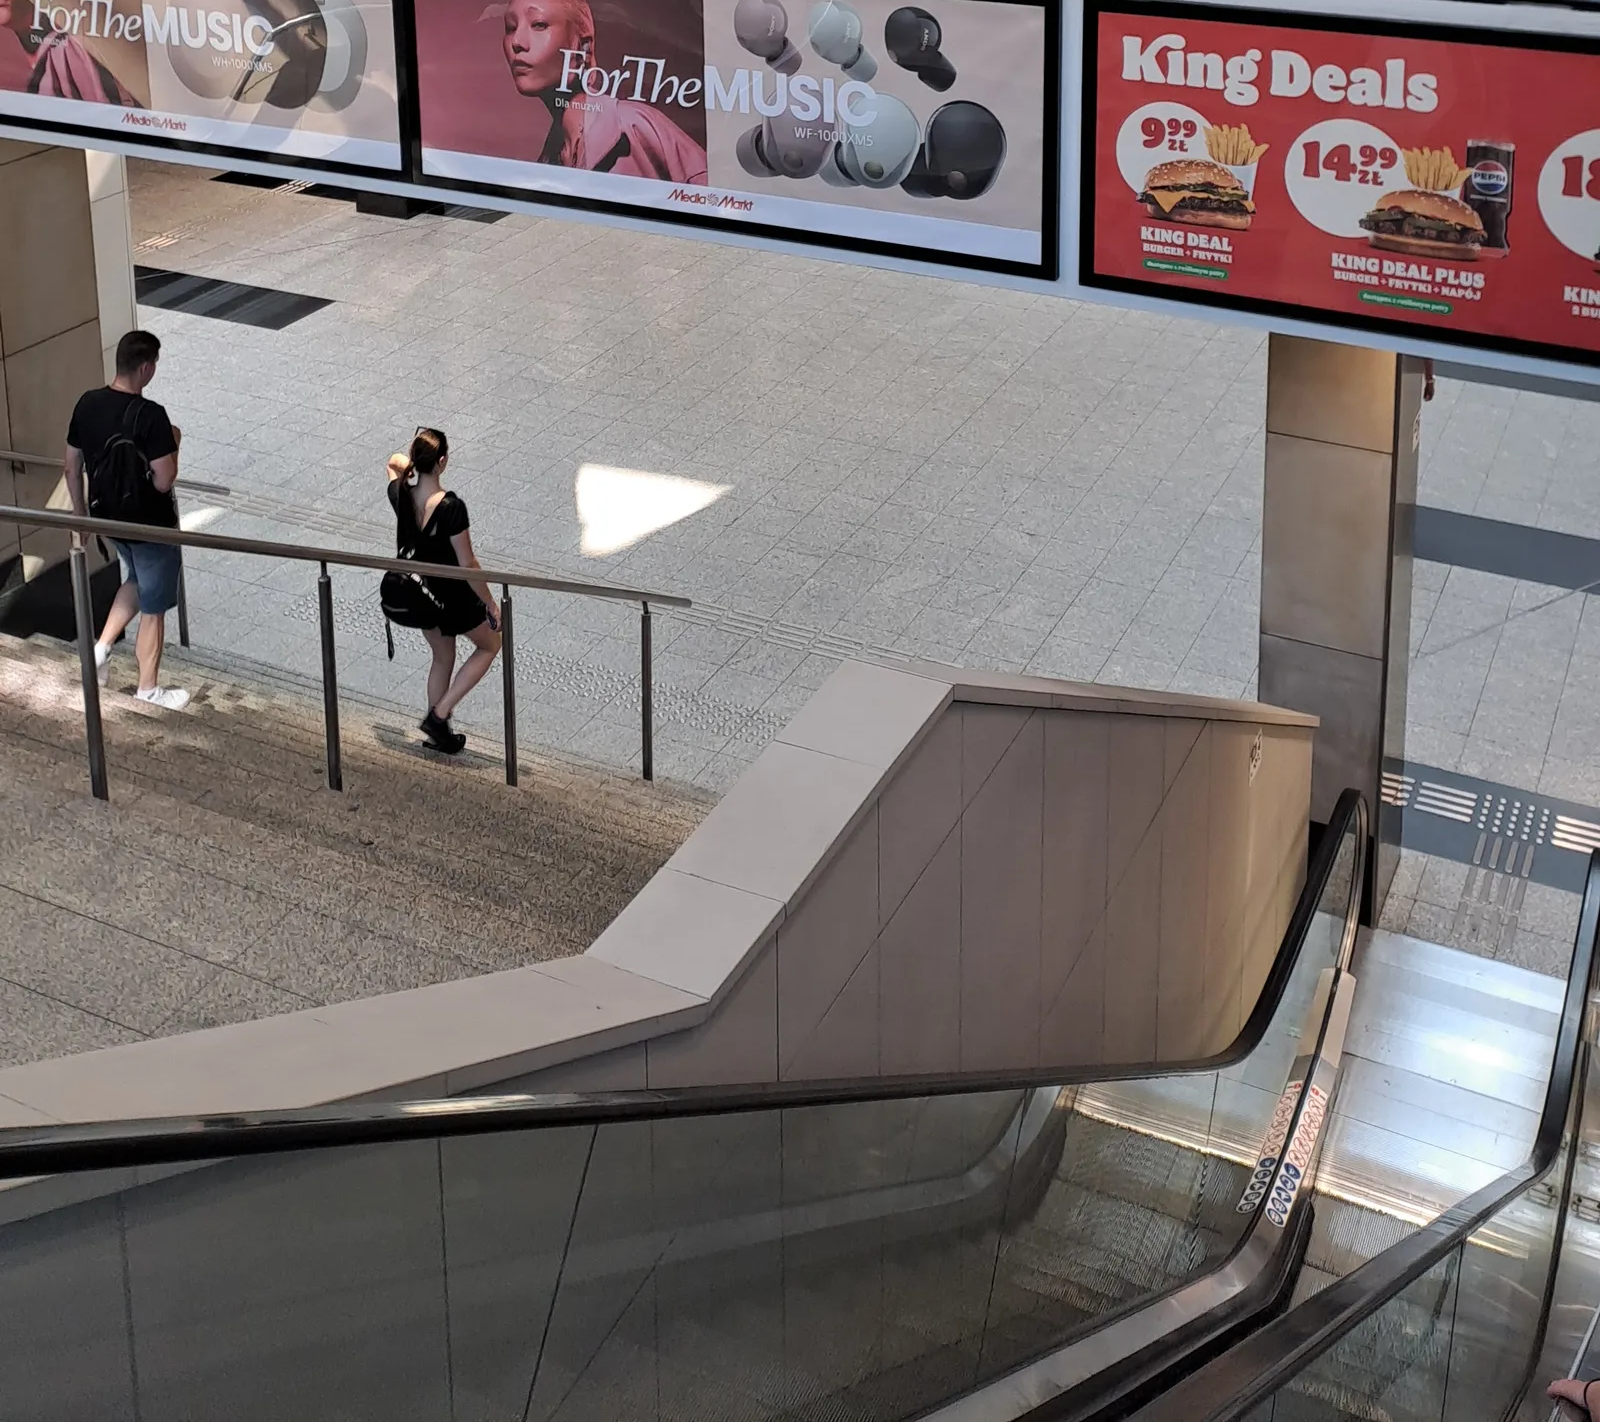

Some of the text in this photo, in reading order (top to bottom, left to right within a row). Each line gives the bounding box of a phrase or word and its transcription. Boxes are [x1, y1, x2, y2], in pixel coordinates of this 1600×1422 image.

[1121, 33, 1439, 113] King Deals
[555, 97, 604, 113] Dla muzyki
[794, 126, 874, 147] WF-1000XM5
[1473, 171, 1506, 183] PEPSI
[1141, 226, 1233, 252] KING DEAL
[1143, 243, 1184, 256] BURGER
[1192, 249, 1233, 264] FRYTKI
[1331, 252, 1485, 289] KING DEAL PLUS
[1333, 270, 1379, 286] BURGER
[1388, 278, 1432, 294] FRYTKI
[1441, 285, 1482, 301] NAPÓJ
[1581, 307, 1600, 319] BU
